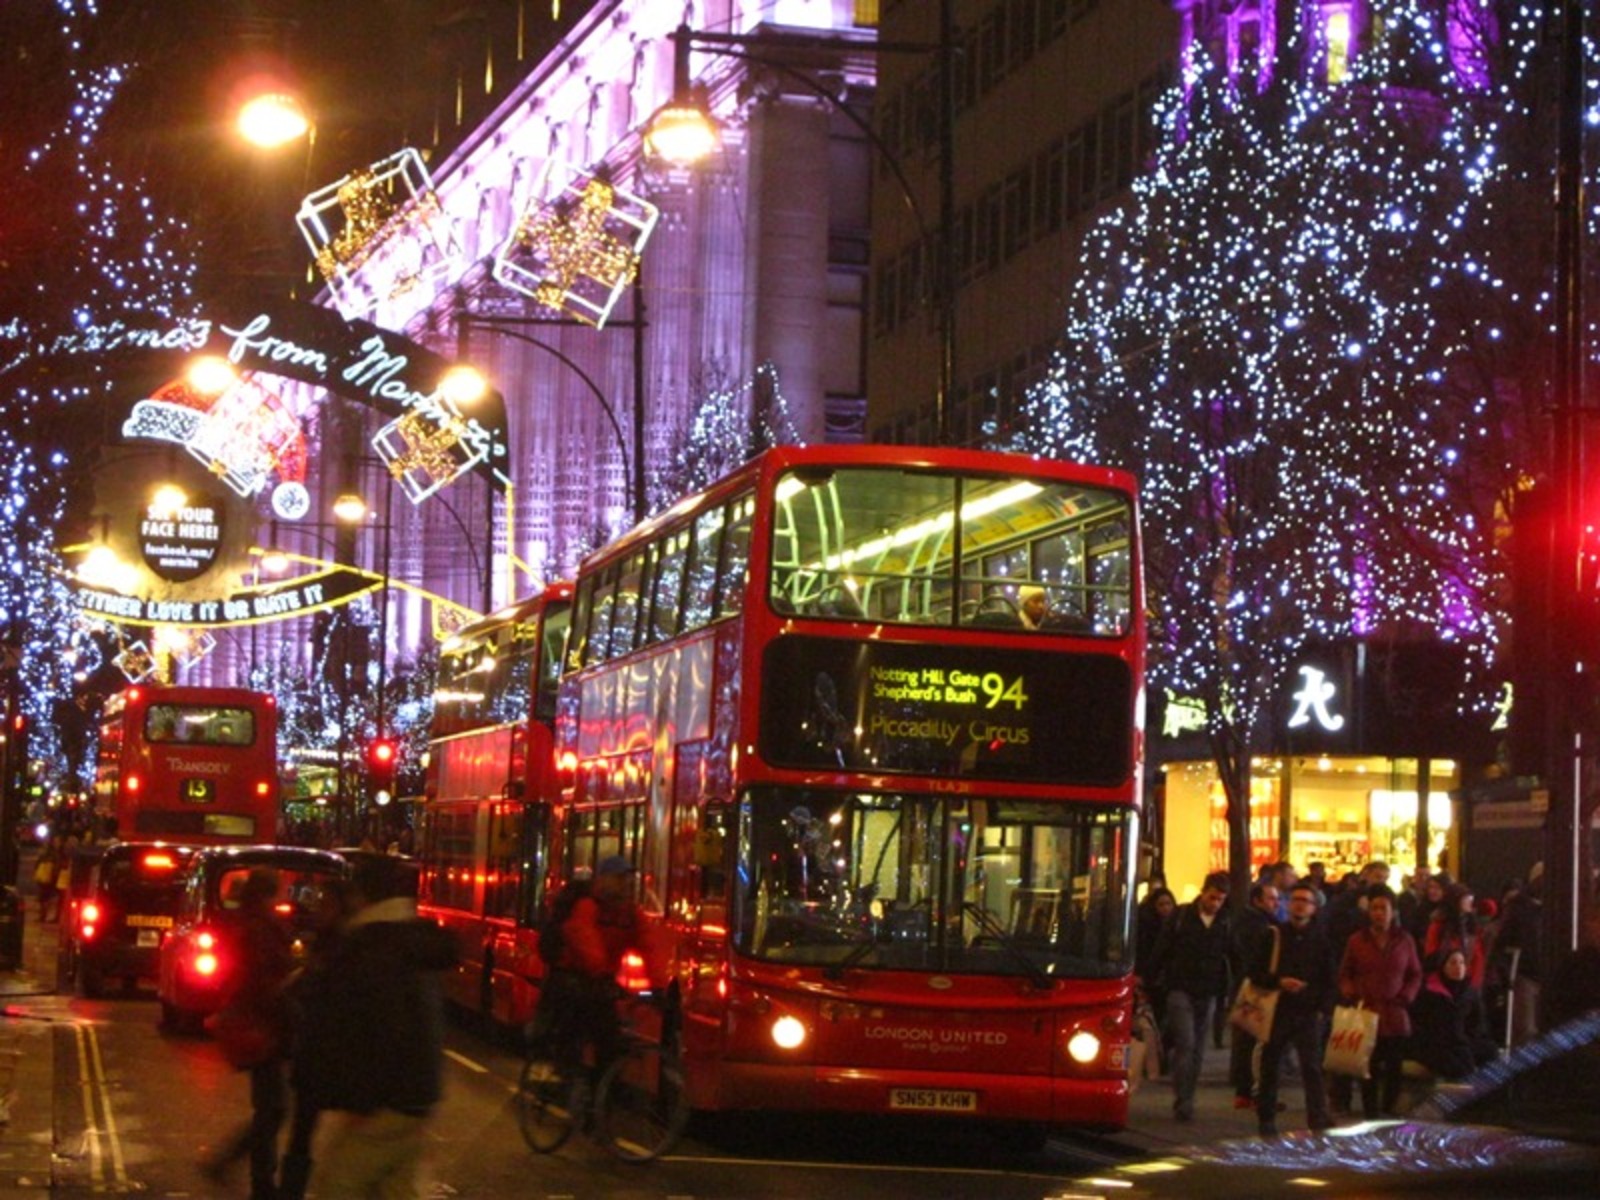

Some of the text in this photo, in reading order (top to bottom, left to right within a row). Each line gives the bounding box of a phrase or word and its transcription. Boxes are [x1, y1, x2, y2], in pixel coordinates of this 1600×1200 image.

[219, 314, 328, 371] from
[176, 506, 215, 522] YOUR
[142, 521, 219, 540] FACE HERE!
[147, 600, 194, 621] LOVE
[200, 601, 219, 620] IT
[253, 591, 301, 616] HATE
[304, 584, 324, 604] IT
[870, 666, 980, 688] Notting Hill Gate
[873, 683, 978, 704] Shepherd's Bush
[981, 671, 1029, 711] 94
[870, 715, 1030, 746] Piccadilly Circus
[865, 1026, 1008, 1046] LONDON UNITED
[895, 1090, 936, 1107] SN53
